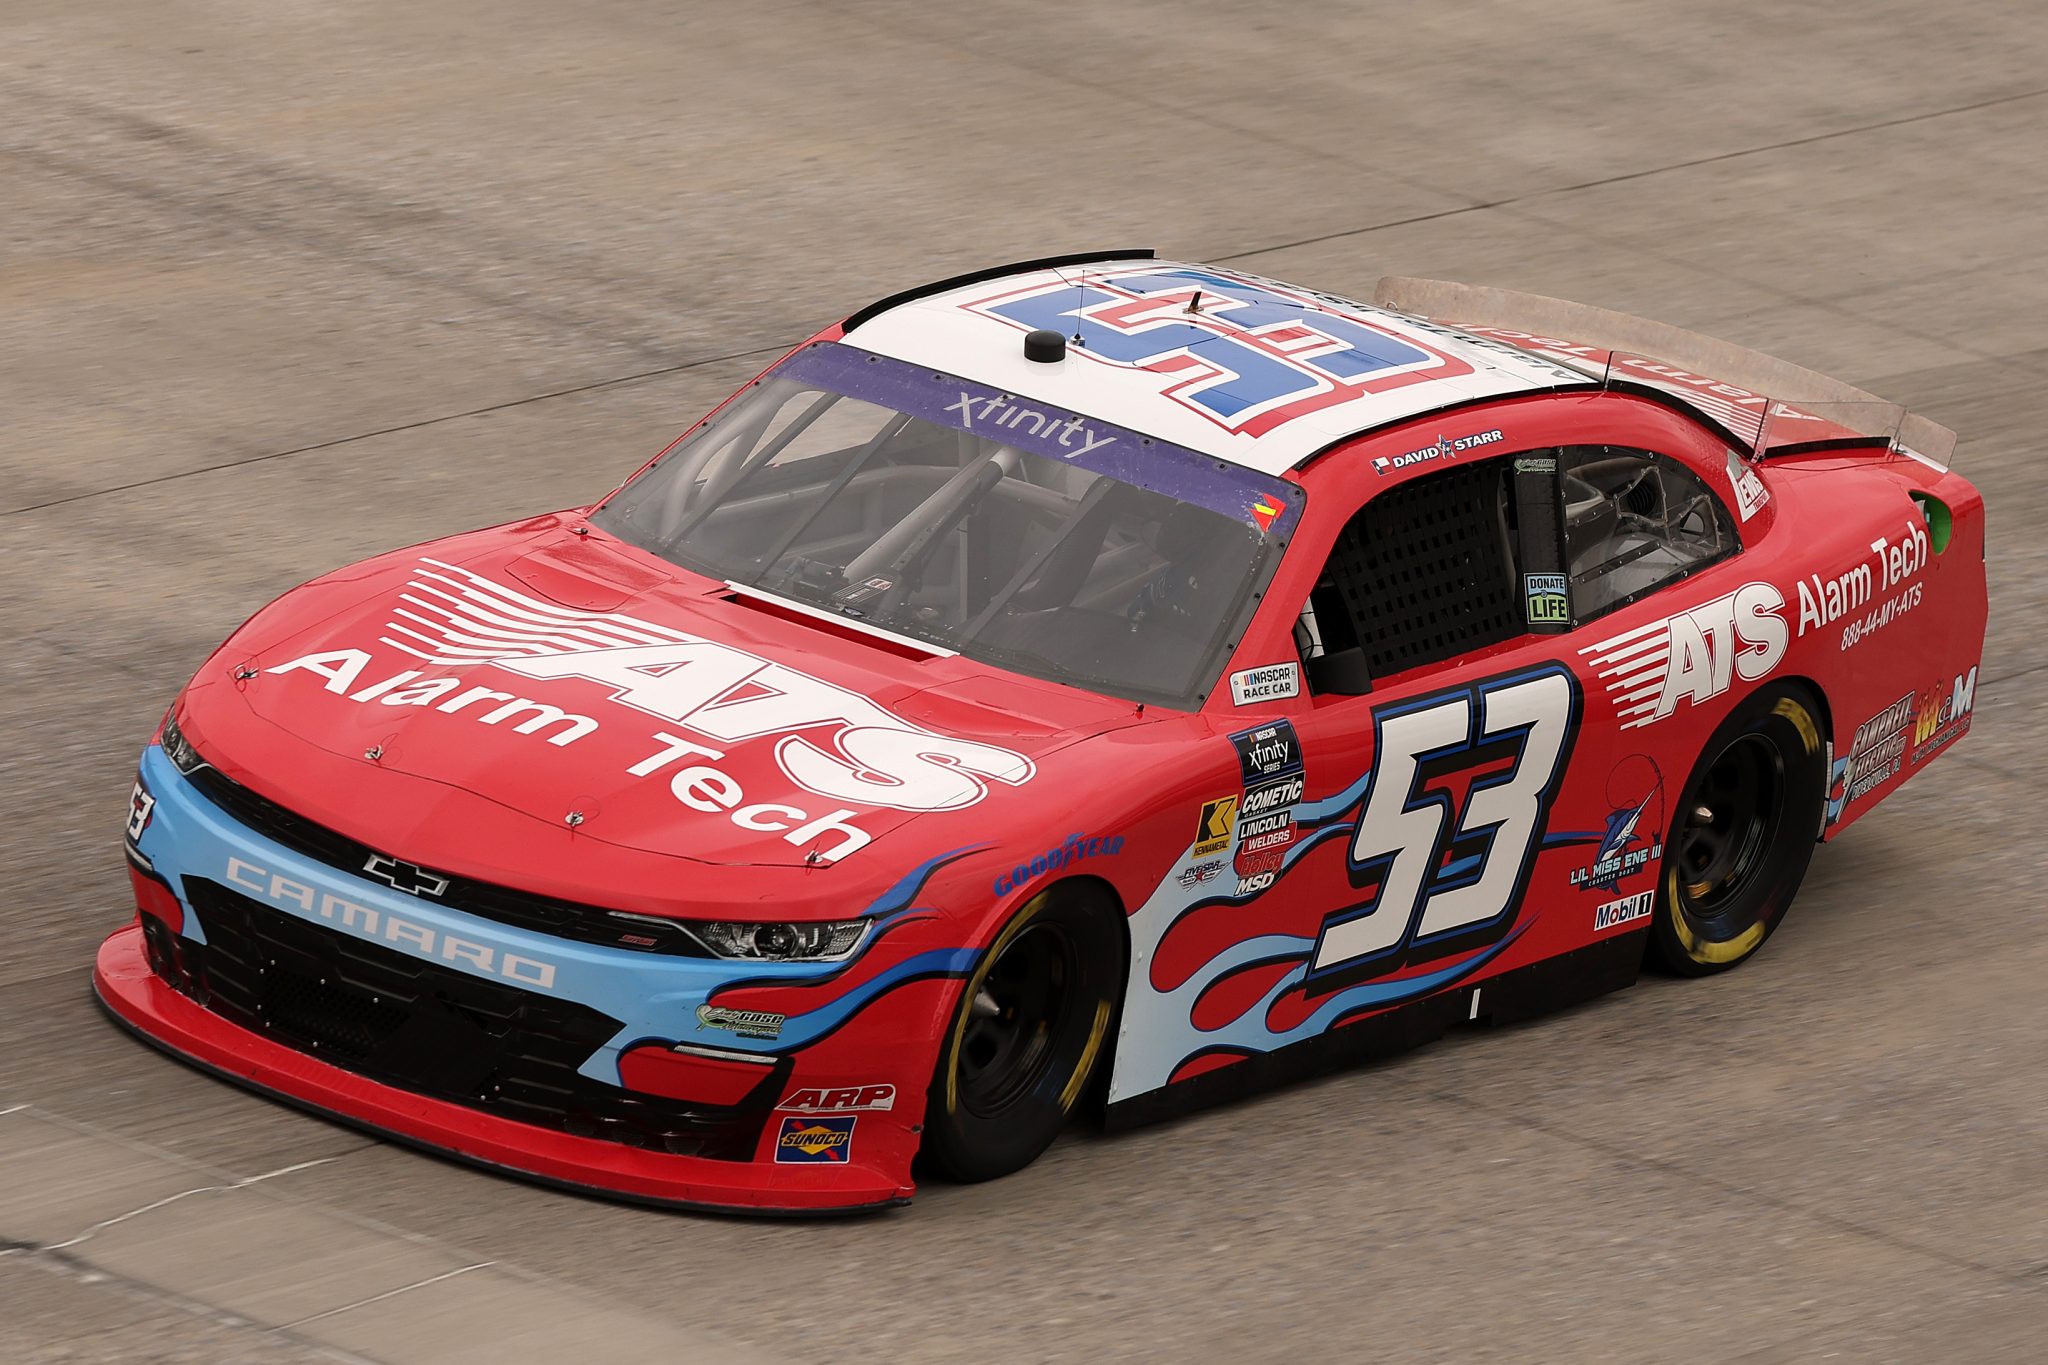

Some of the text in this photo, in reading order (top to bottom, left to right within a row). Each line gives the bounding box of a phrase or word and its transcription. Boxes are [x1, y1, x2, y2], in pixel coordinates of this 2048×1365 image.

[943, 391, 1118, 459] xfinity
[1392, 430, 1504, 468] DAVID STARR
[1530, 577, 1565, 589] DONATE
[1797, 521, 1928, 637] Alarm Tech
[1532, 599, 1567, 618] LIFE
[1841, 581, 1923, 651] 888-44-MY-ATS
[1652, 581, 1789, 721] ATS
[1243, 683, 1291, 699] RACE CAR
[1253, 667, 1291, 685] NASCAR
[487, 640, 1038, 813] ATS
[1255, 727, 1277, 741] NASCAR
[268, 647, 873, 864] Alarm Tech
[1248, 740, 1289, 771] xfinity
[1263, 761, 1281, 774] SERIES
[1242, 780, 1303, 814] COMETIC
[1240, 813, 1289, 839] LINCOLN
[1312, 674, 1570, 971] 53
[1248, 829, 1290, 851] WELDERS
[993, 833, 1125, 897] GOODYEAR
[1570, 867, 1589, 885] LIL
[1593, 856, 1622, 878] MISS
[1624, 848, 1649, 868] ENE
[1234, 872, 1275, 896] MSD
[226, 856, 556, 989] CAMARO
[1596, 897, 1637, 928] Mobil
[780, 1085, 895, 1108] ARP
[782, 1132, 848, 1146] SUNOCO
